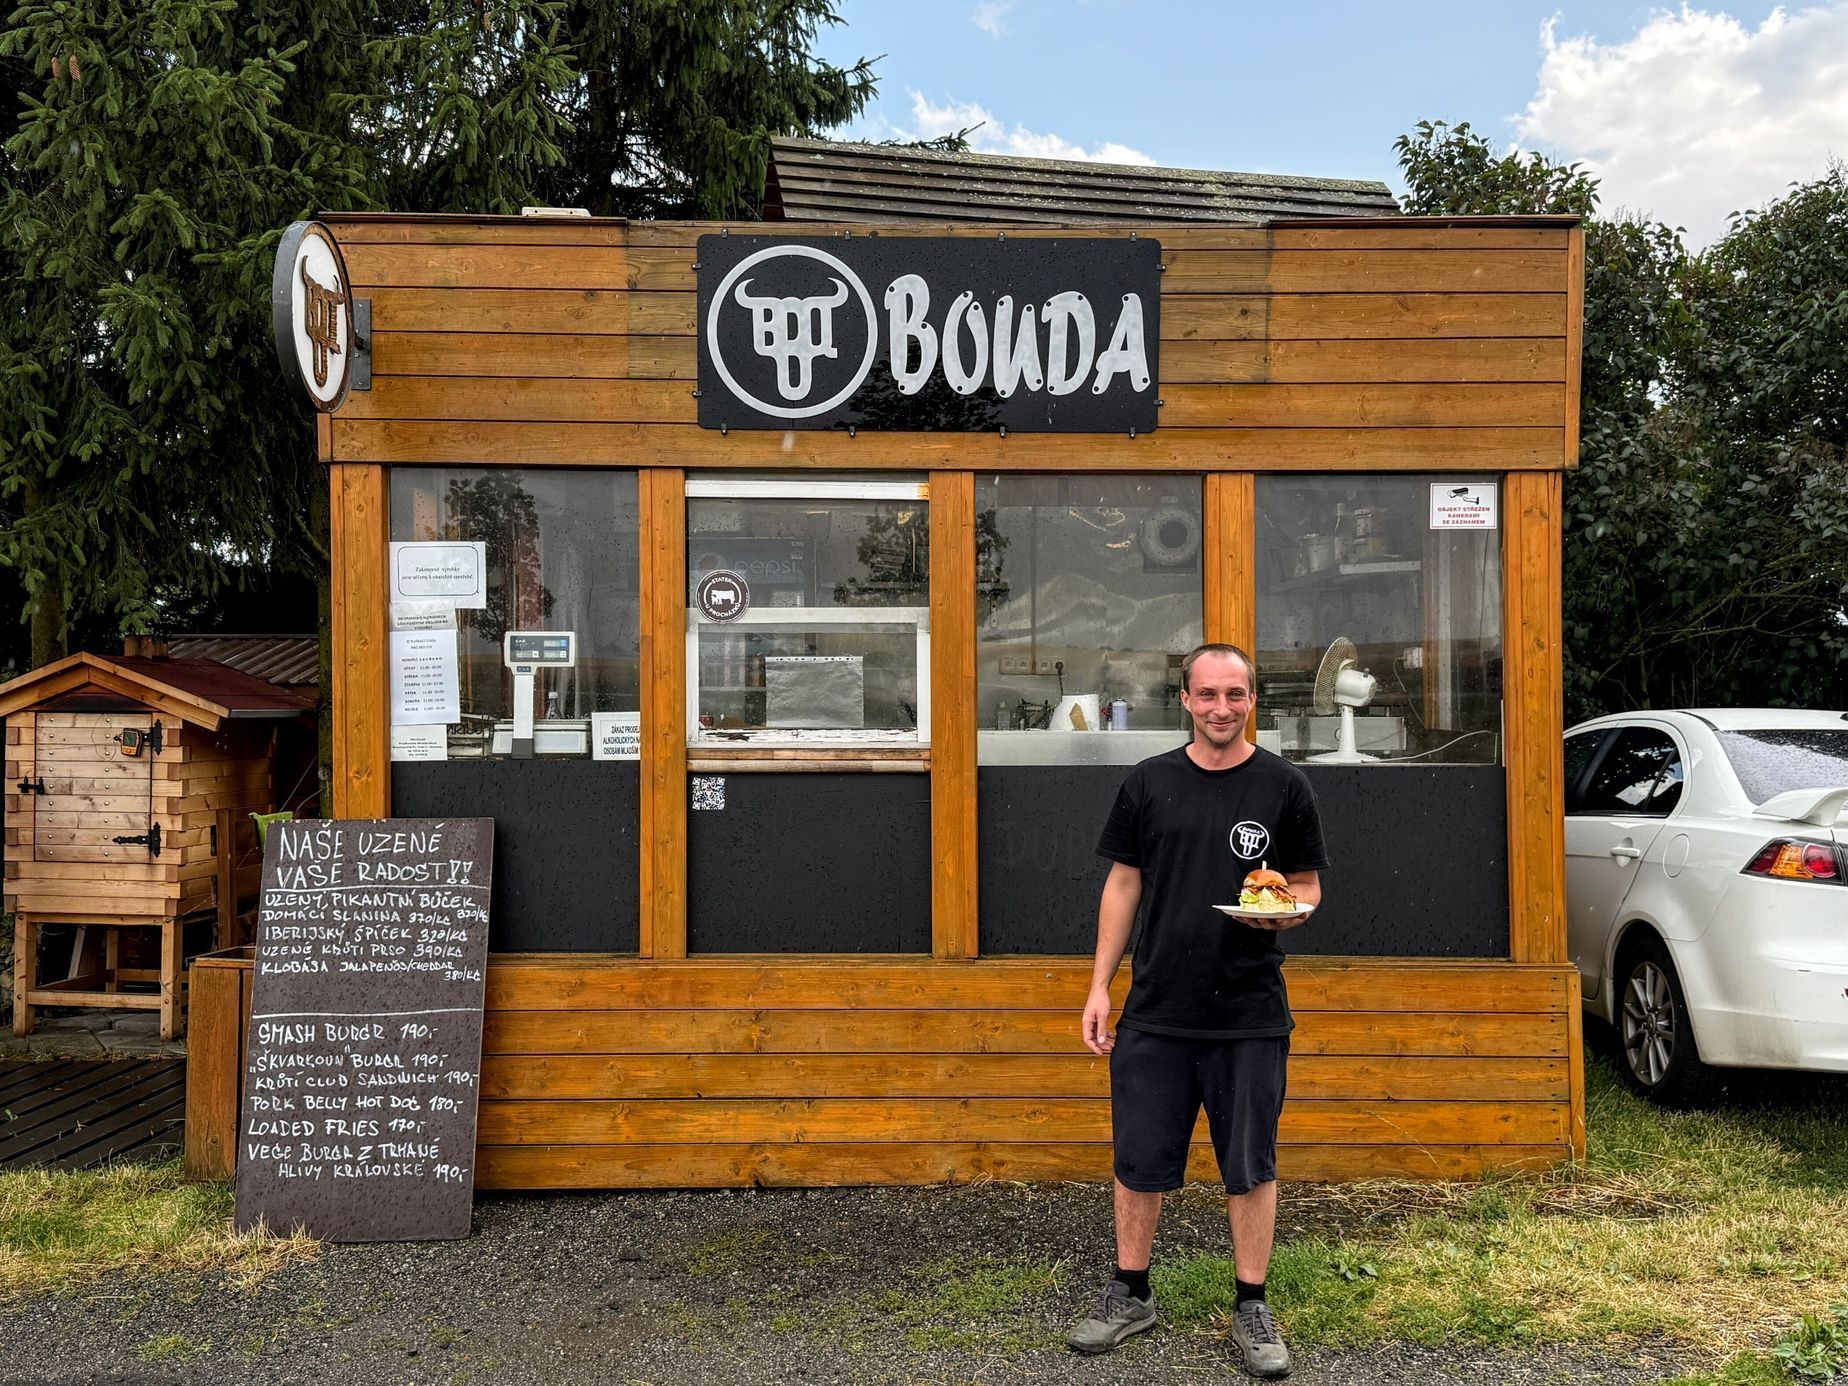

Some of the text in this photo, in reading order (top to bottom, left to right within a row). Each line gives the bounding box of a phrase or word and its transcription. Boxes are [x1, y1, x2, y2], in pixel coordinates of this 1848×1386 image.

[884, 273, 1151, 399] BOUDA
[711, 576, 733, 584] STATEK
[611, 724, 625, 734] ZÁKAZ
[279, 822, 445, 862] NAŠE UZENÉ
[276, 859, 343, 889] VAŠE
[265, 890, 327, 908] UZENÝ
[331, 889, 417, 909] PIKANTNÍ
[260, 903, 329, 921] DOMÁCÍ
[332, 909, 401, 922] SLANINA
[265, 922, 346, 944] IBERIJSKÝ
[354, 923, 413, 943] ŠPÍČEK
[262, 941, 313, 957] UZENÉ
[370, 943, 406, 957] PRSO
[260, 956, 329, 976] KLOBÁSA
[258, 1021, 316, 1046] SMASH
[324, 1022, 386, 1041] BURGR
[349, 1053, 405, 1069] BURGR
[357, 1071, 440, 1088] SANDWICH
[250, 1095, 296, 1112] PORK
[303, 1095, 348, 1111] BELLY
[355, 1095, 385, 1109] HOT
[389, 1094, 421, 1111] DOG
[248, 1118, 315, 1136] LOADED
[324, 1119, 380, 1137] FRIES
[299, 1142, 354, 1163] BURGR
[357, 1145, 375, 1161] Z
[378, 1137, 441, 1159] TRHANÉ
[333, 1159, 426, 1178] KRÁLOVSKÉ
